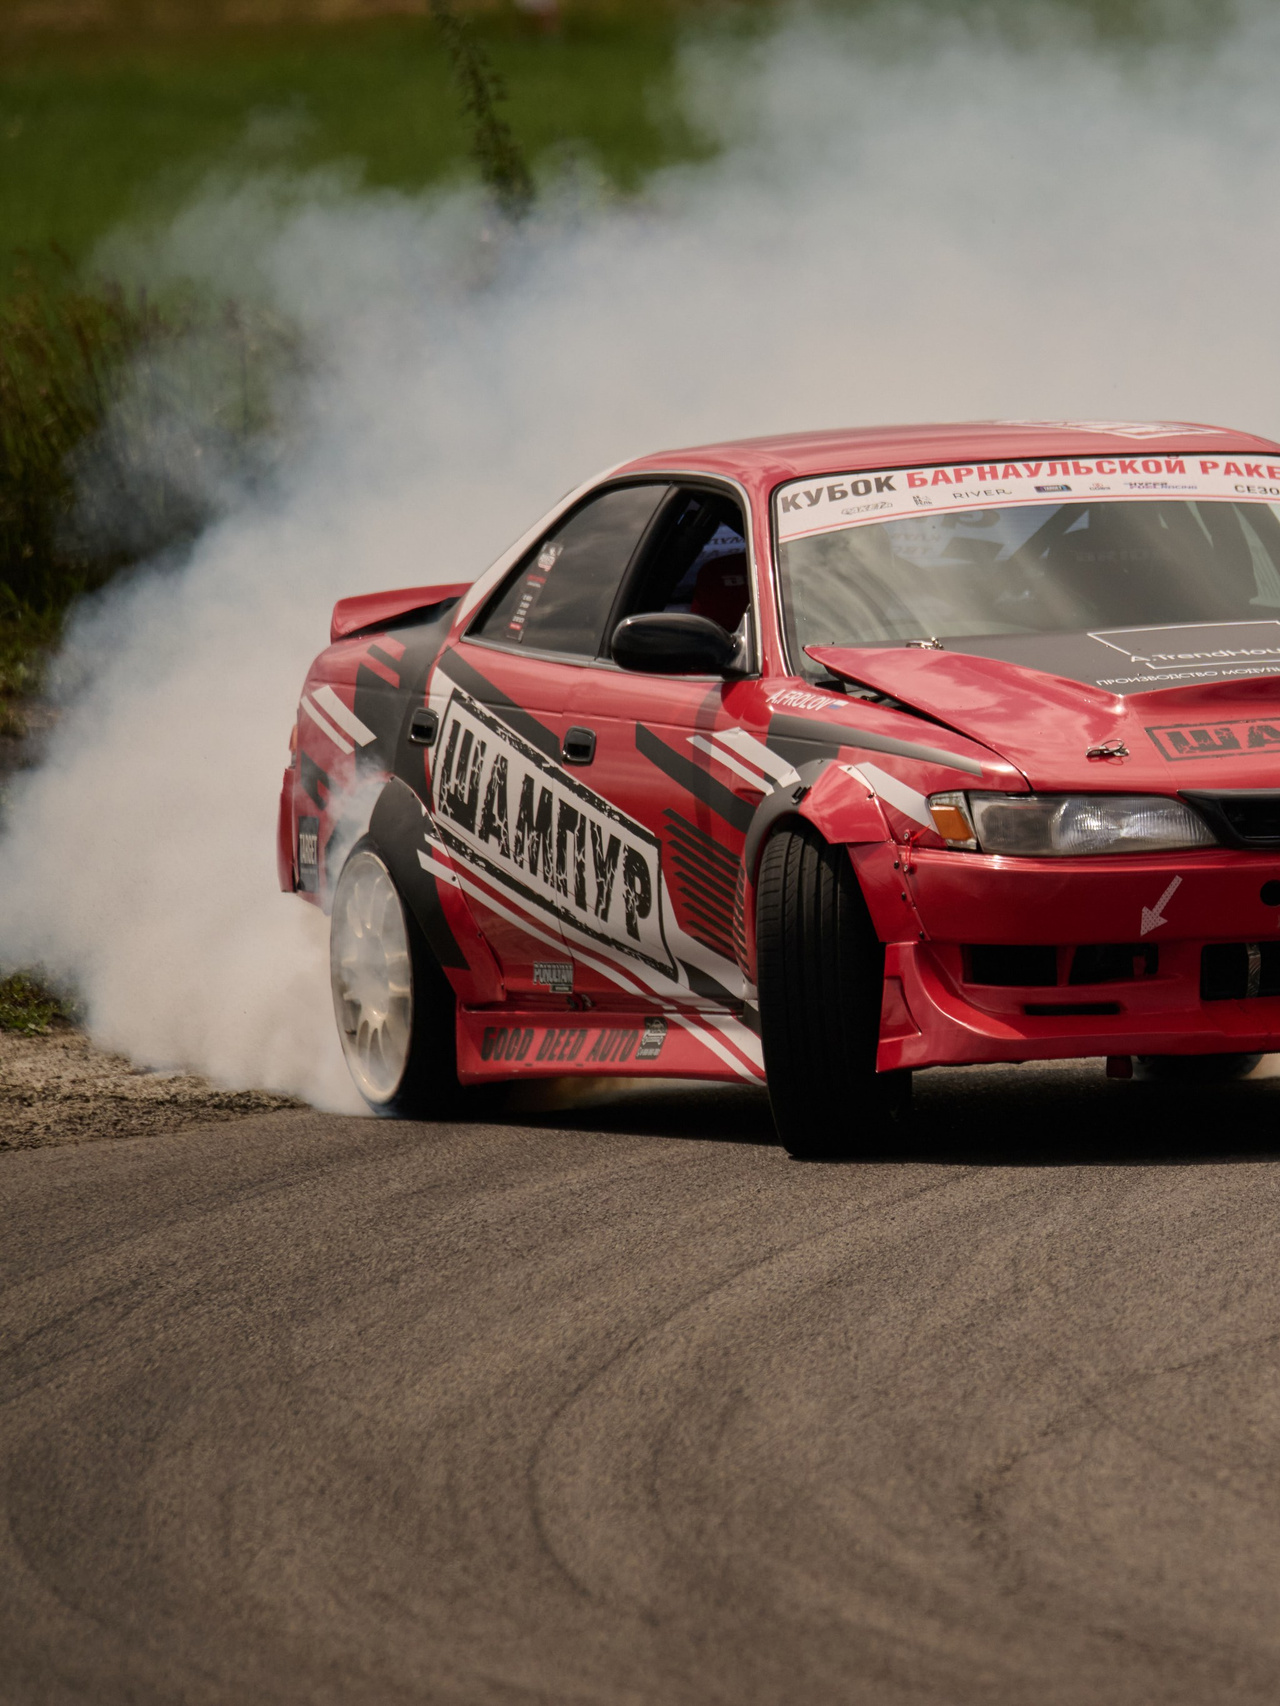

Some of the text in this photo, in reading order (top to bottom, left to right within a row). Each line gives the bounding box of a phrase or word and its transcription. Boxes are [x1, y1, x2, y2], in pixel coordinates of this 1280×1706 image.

[780, 475, 897, 514] КУБОК
[906, 456, 1186, 489] БАРНАУЛЬСКОЙ
[953, 488, 1012, 499] RIVER
[1096, 669, 1218, 686] ПРОИЗВОДСТВО
[765, 688, 835, 711] A.FROLOV
[438, 718, 653, 943] ШАМПУР
